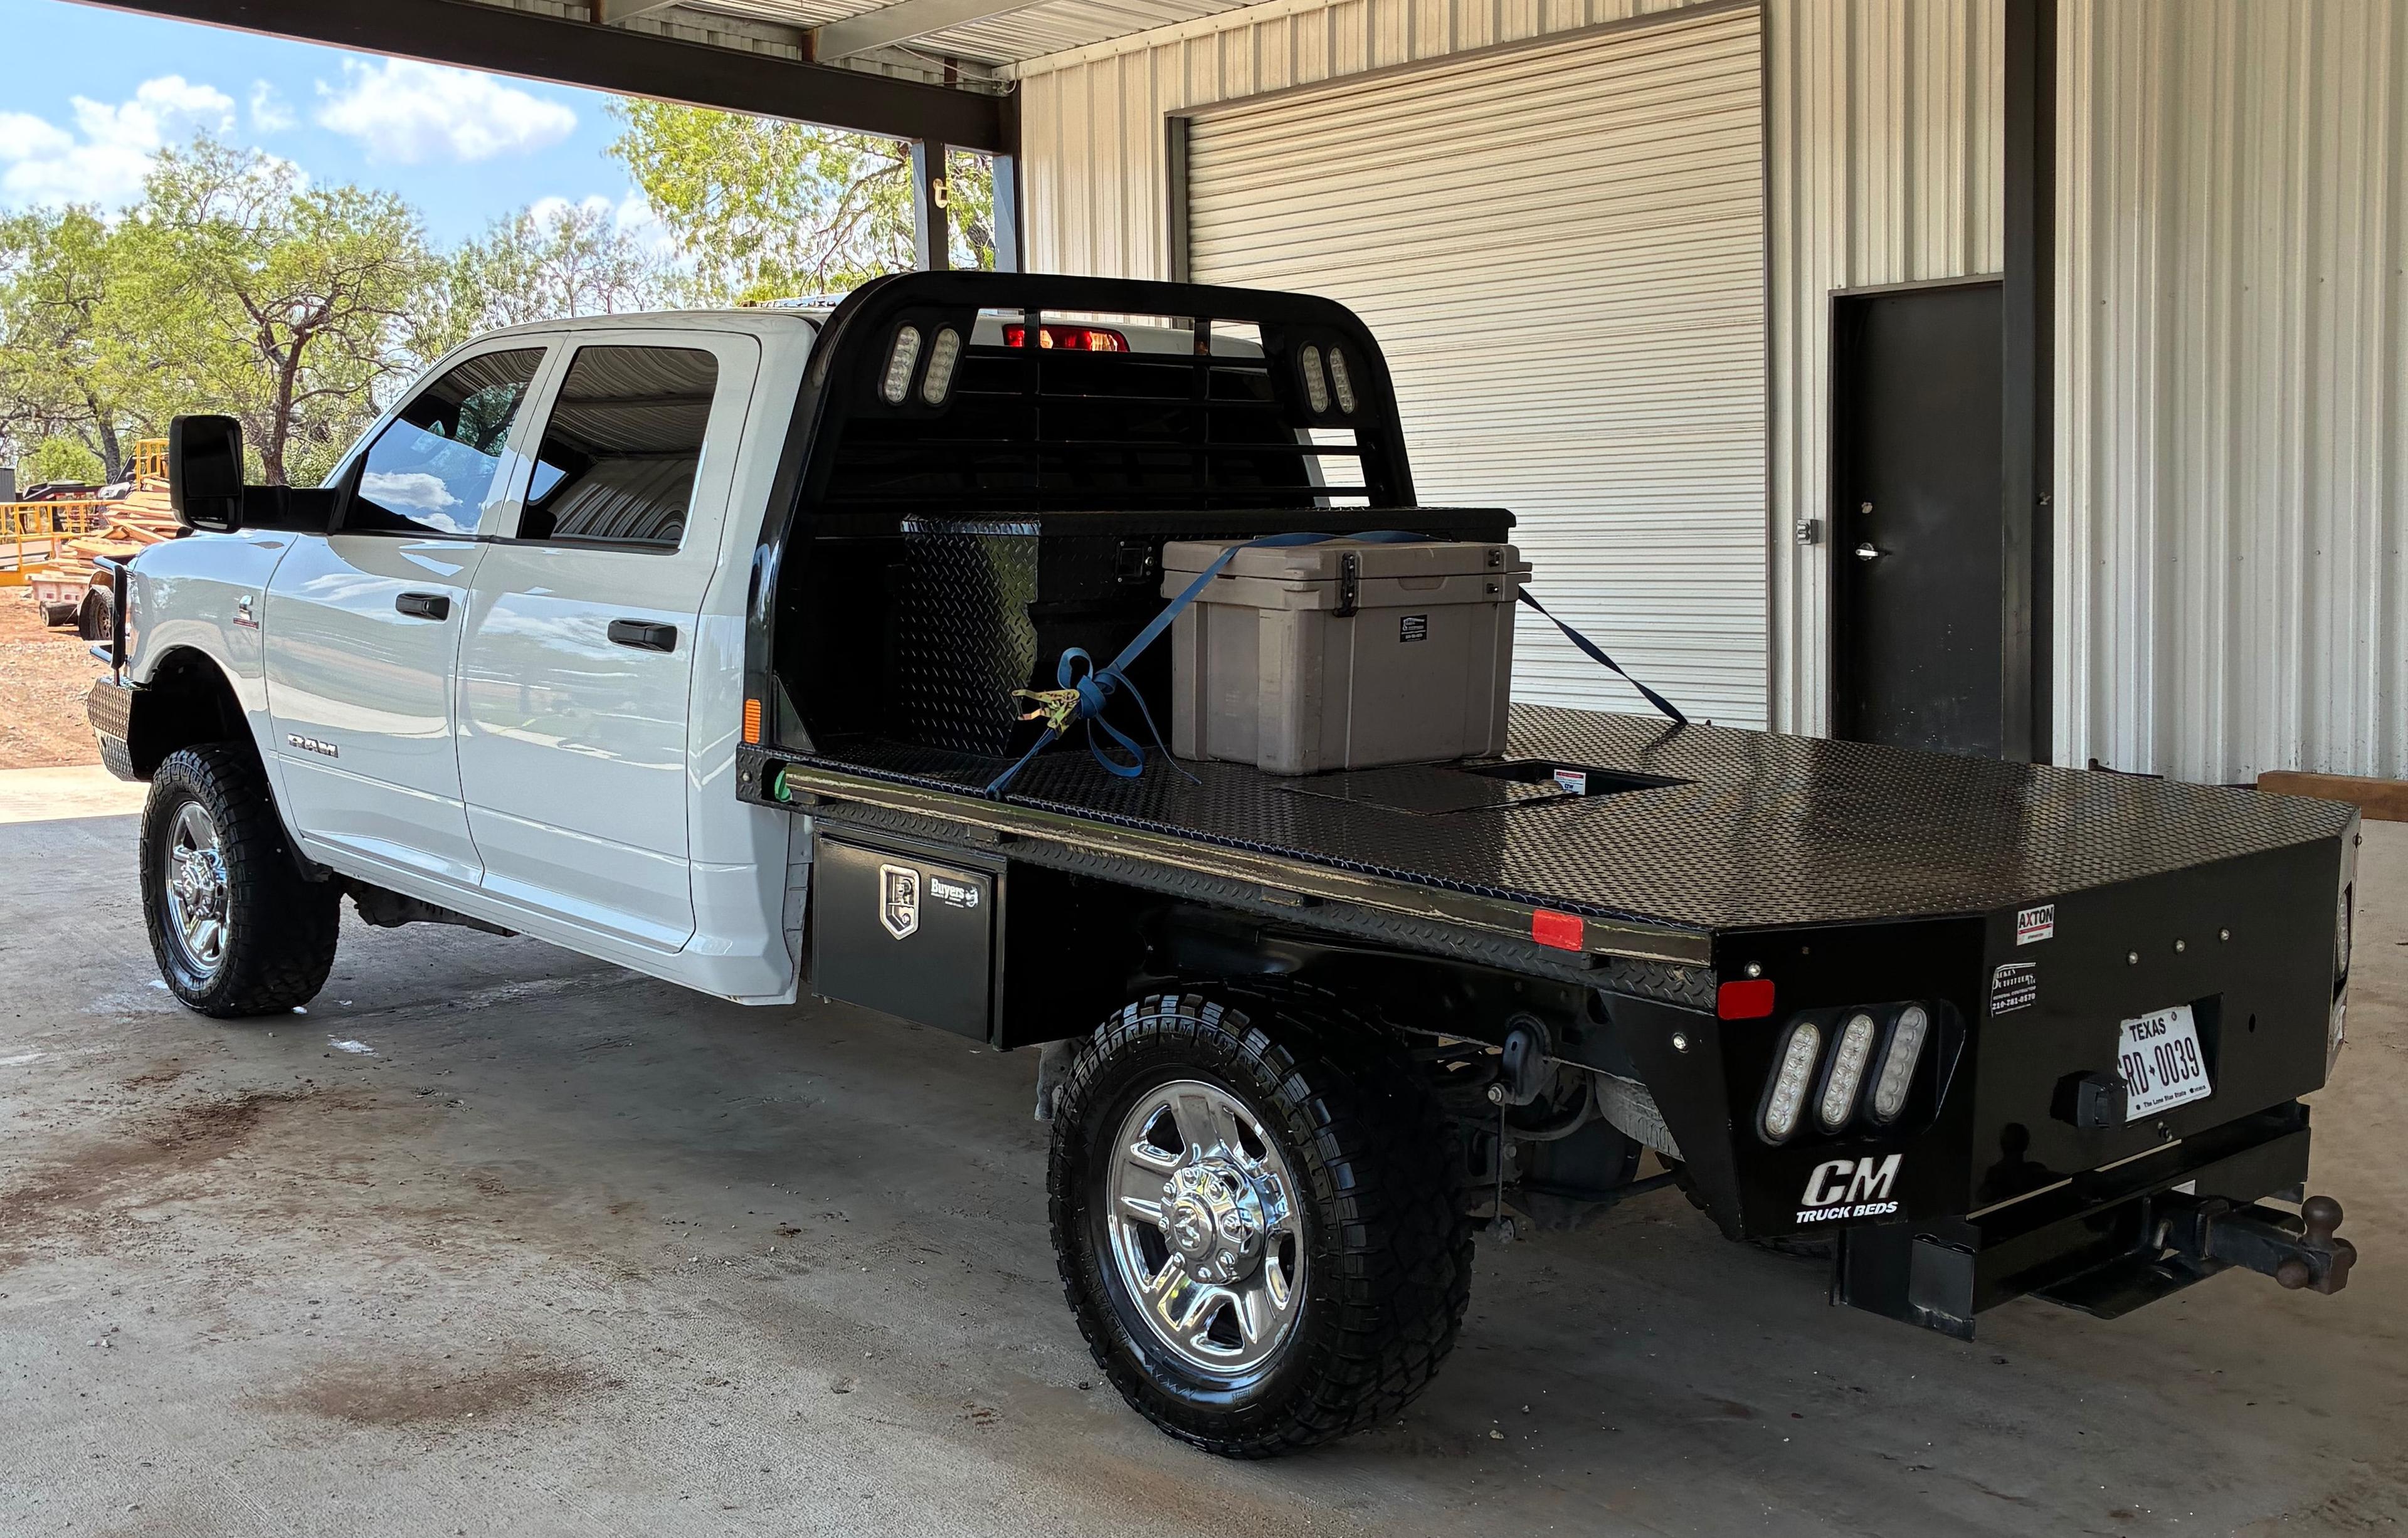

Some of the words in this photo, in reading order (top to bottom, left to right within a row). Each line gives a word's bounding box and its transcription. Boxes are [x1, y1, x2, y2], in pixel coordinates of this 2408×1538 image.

[288, 733, 339, 758] RAM
[931, 878, 964, 899] Buyers
[2019, 907, 2054, 929] AXTON
[2129, 1017, 2166, 1042] TEXAS
[2117, 1051, 2149, 1097] RD
[1802, 1154, 1904, 1206] CM
[1796, 1206, 1850, 1223] TRUCK
[1853, 1201, 1899, 1217] BEDS
